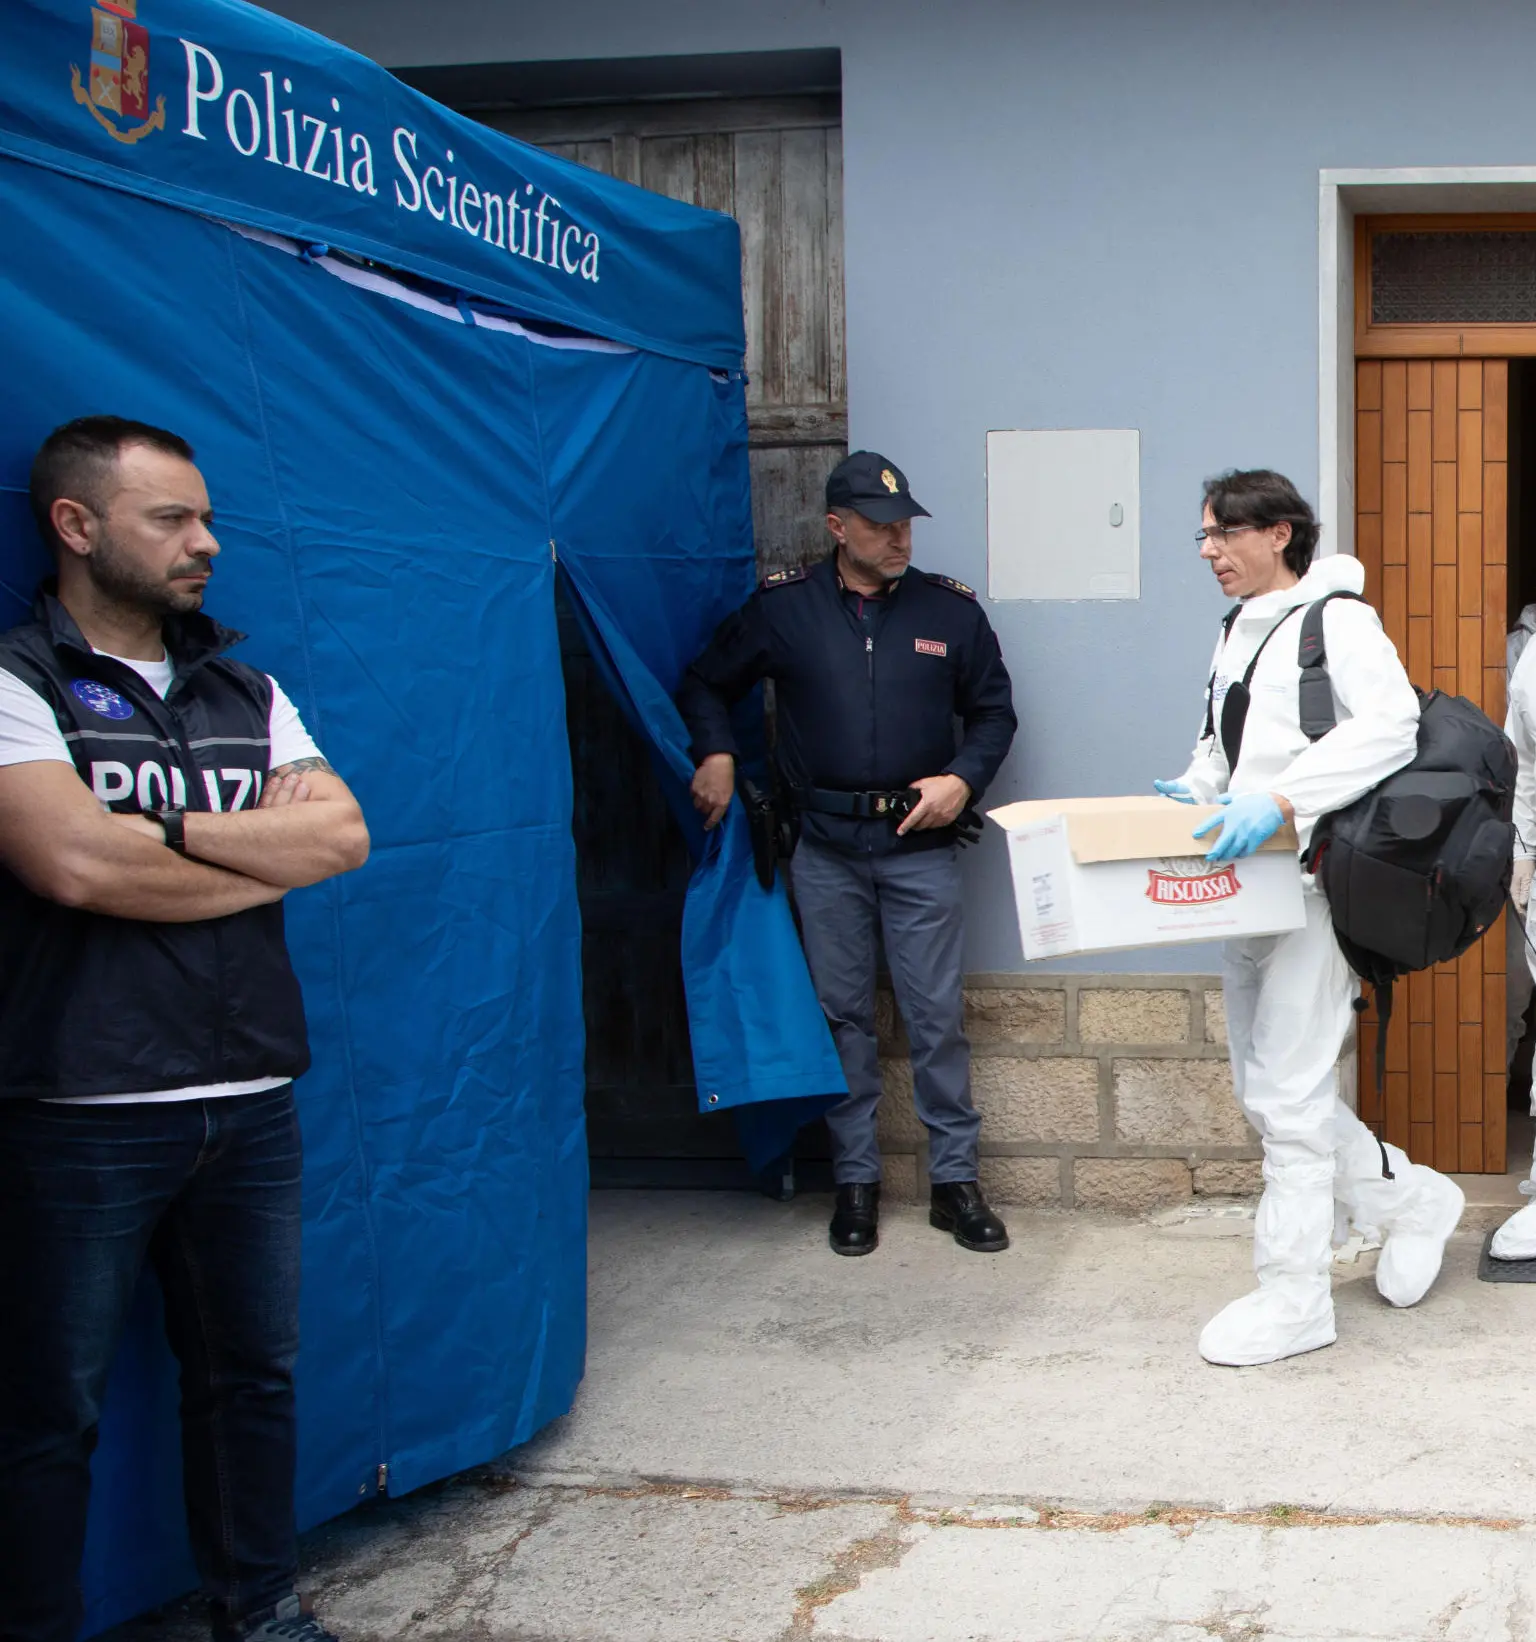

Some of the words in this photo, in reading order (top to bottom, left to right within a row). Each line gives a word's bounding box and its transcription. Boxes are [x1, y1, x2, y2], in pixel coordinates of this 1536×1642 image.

[178, 37, 378, 197] Polizia
[392, 127, 600, 283] Scientifica
[917, 641, 945, 653] POLIZIA
[1157, 875, 1232, 901] RISCOSSA
